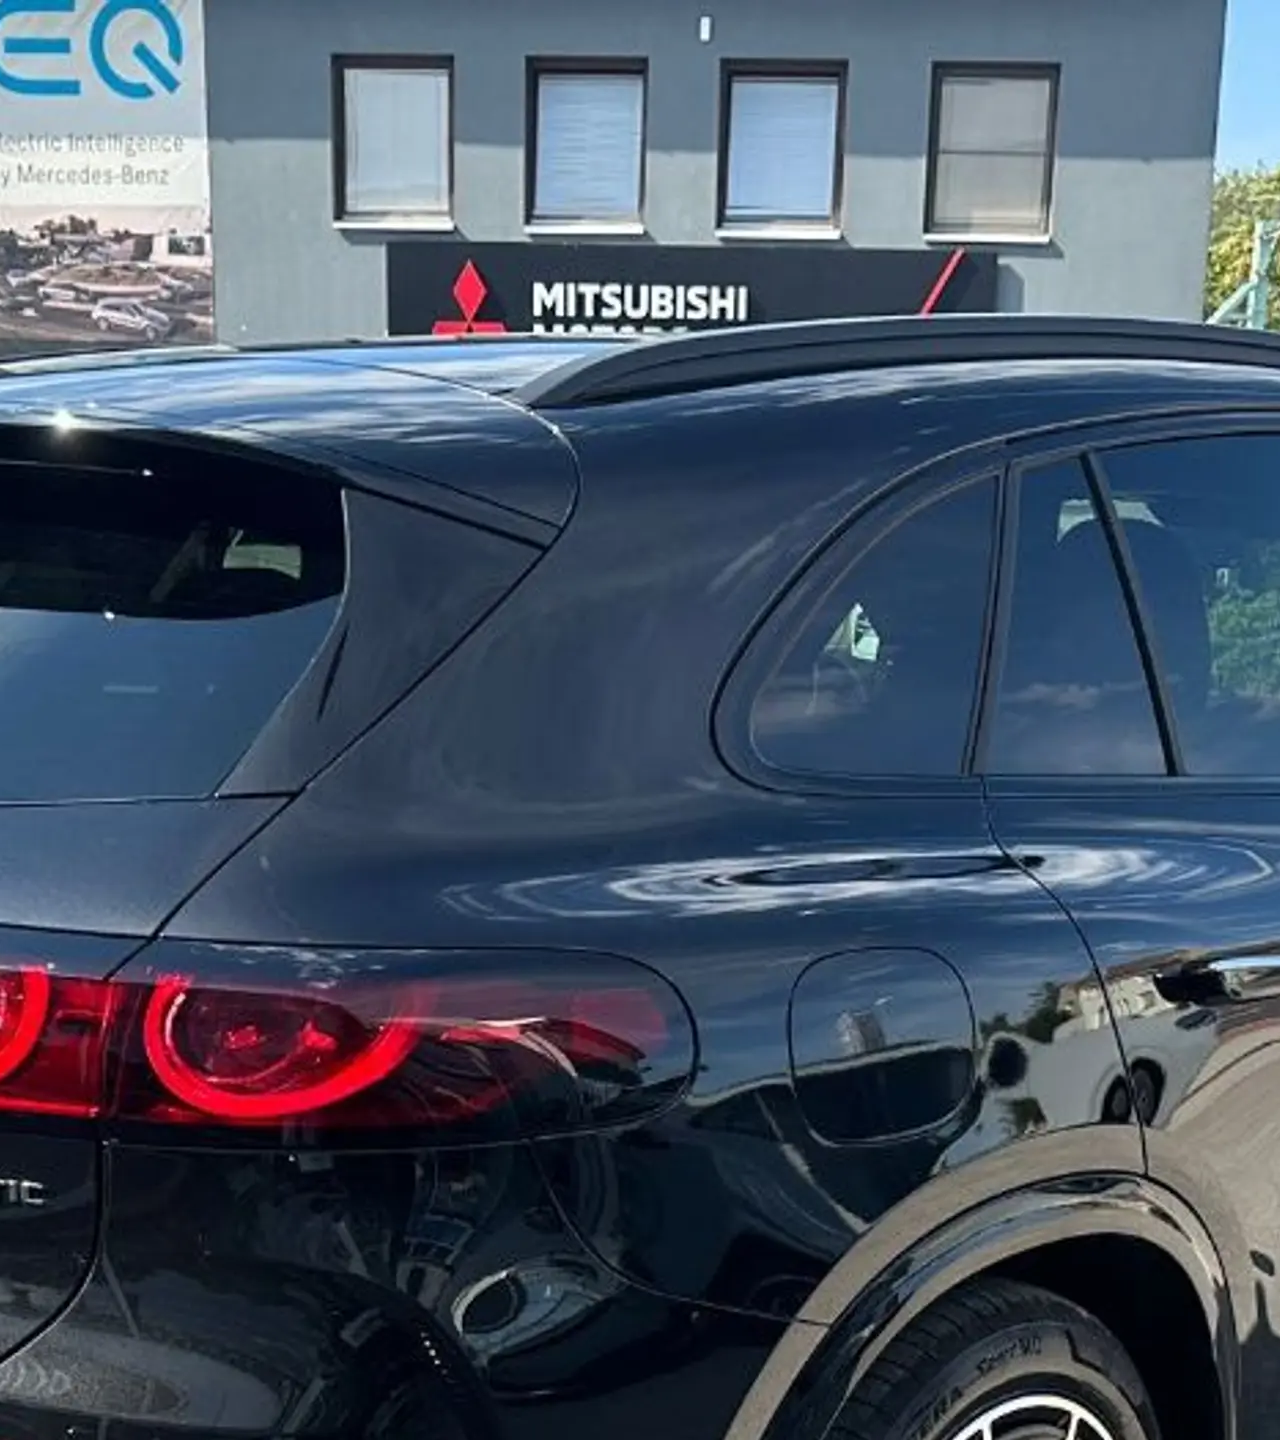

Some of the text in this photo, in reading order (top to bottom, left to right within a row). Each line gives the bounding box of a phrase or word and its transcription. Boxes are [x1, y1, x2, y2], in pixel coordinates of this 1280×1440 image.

[68, 131, 184, 157] Intelligence
[17, 164, 170, 185] Mercedes-Benz
[532, 281, 748, 321] MITSUBISHI
